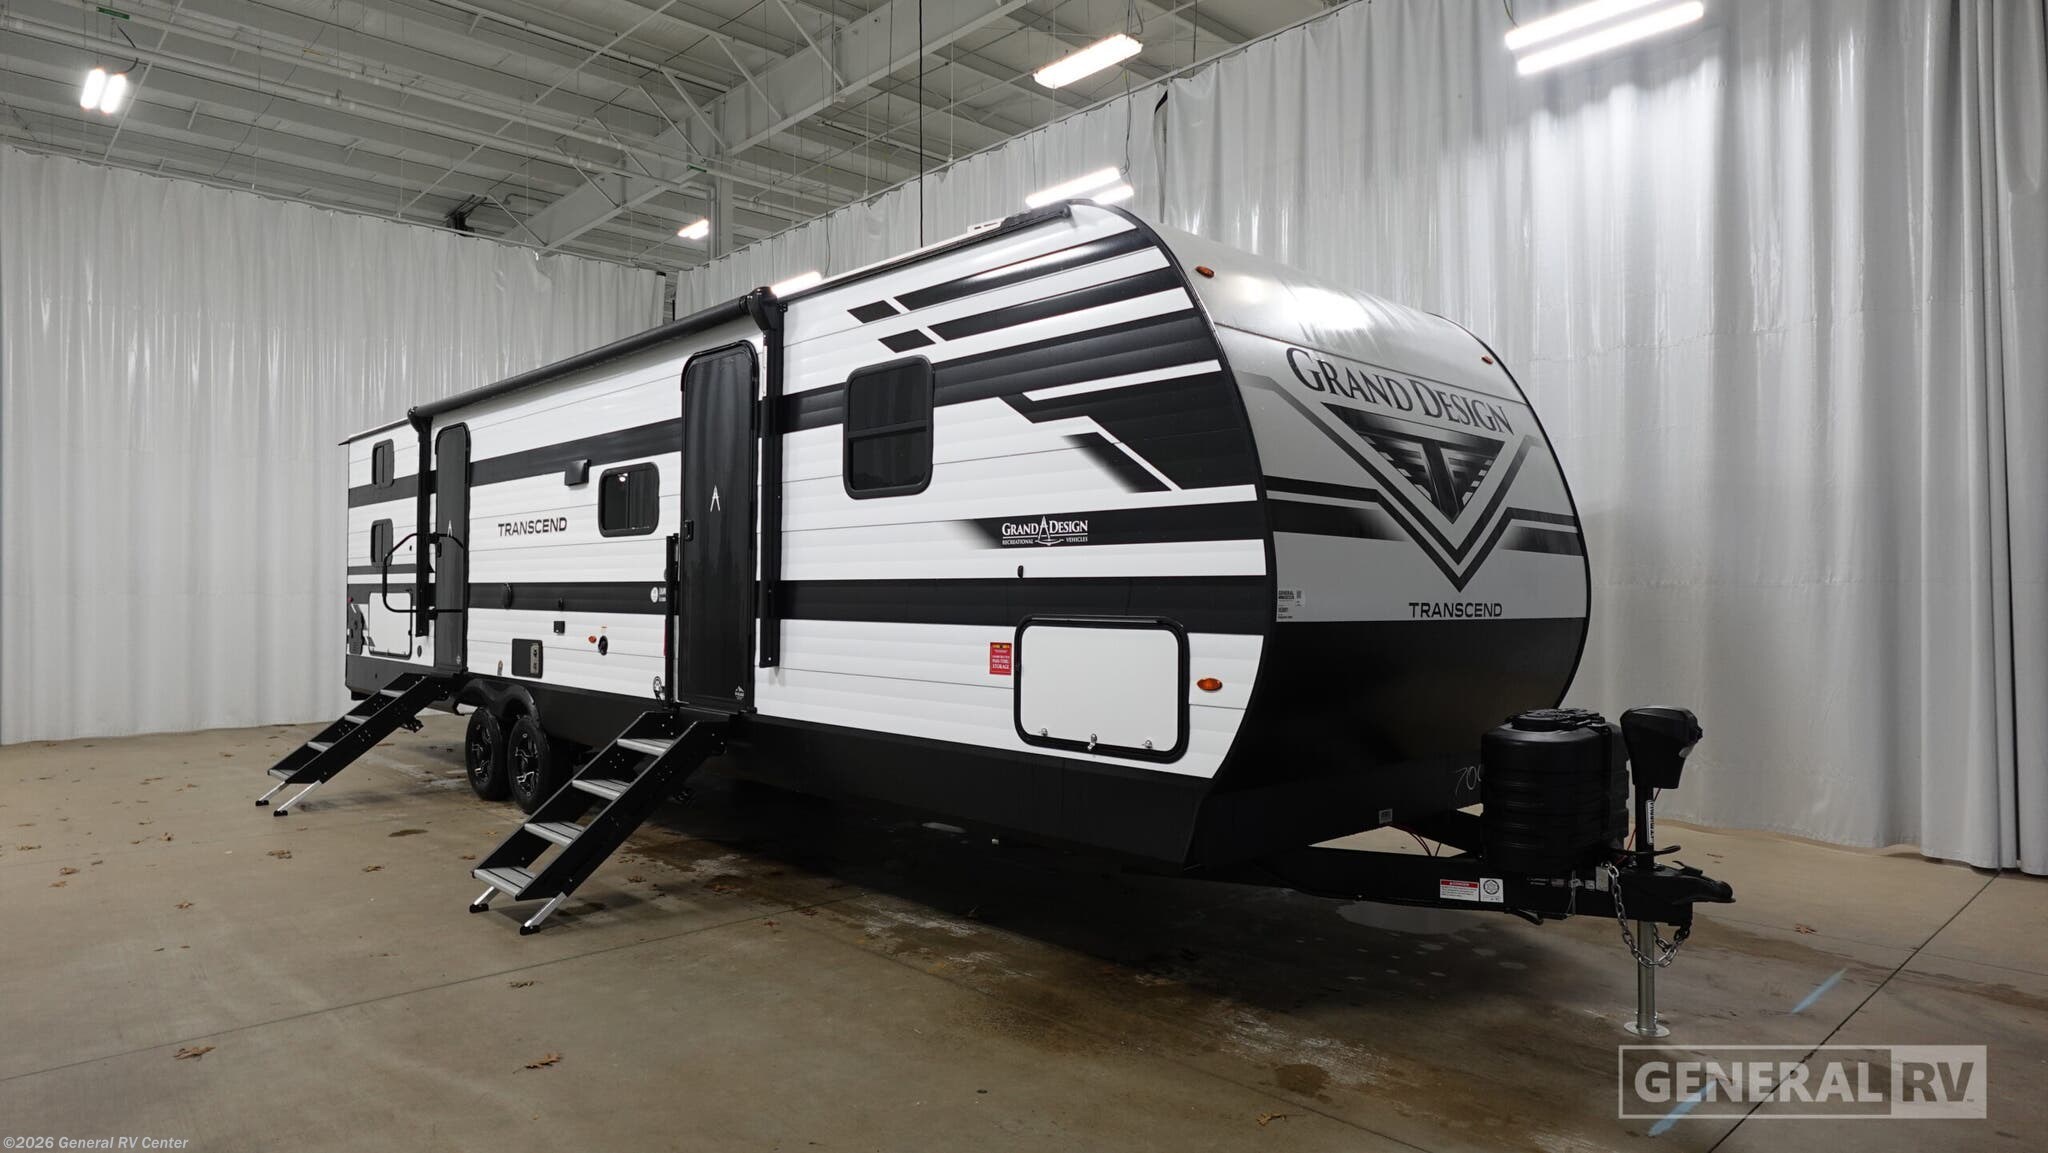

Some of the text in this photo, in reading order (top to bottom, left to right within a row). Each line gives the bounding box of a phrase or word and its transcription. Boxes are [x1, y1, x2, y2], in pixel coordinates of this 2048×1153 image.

[1286, 347, 1514, 435] GRAND DESIGN
[498, 517, 567, 536] TRANSCEND
[1002, 520, 1088, 536] GRAND DESIGN
[1408, 602, 1502, 618] TRANSCEND
